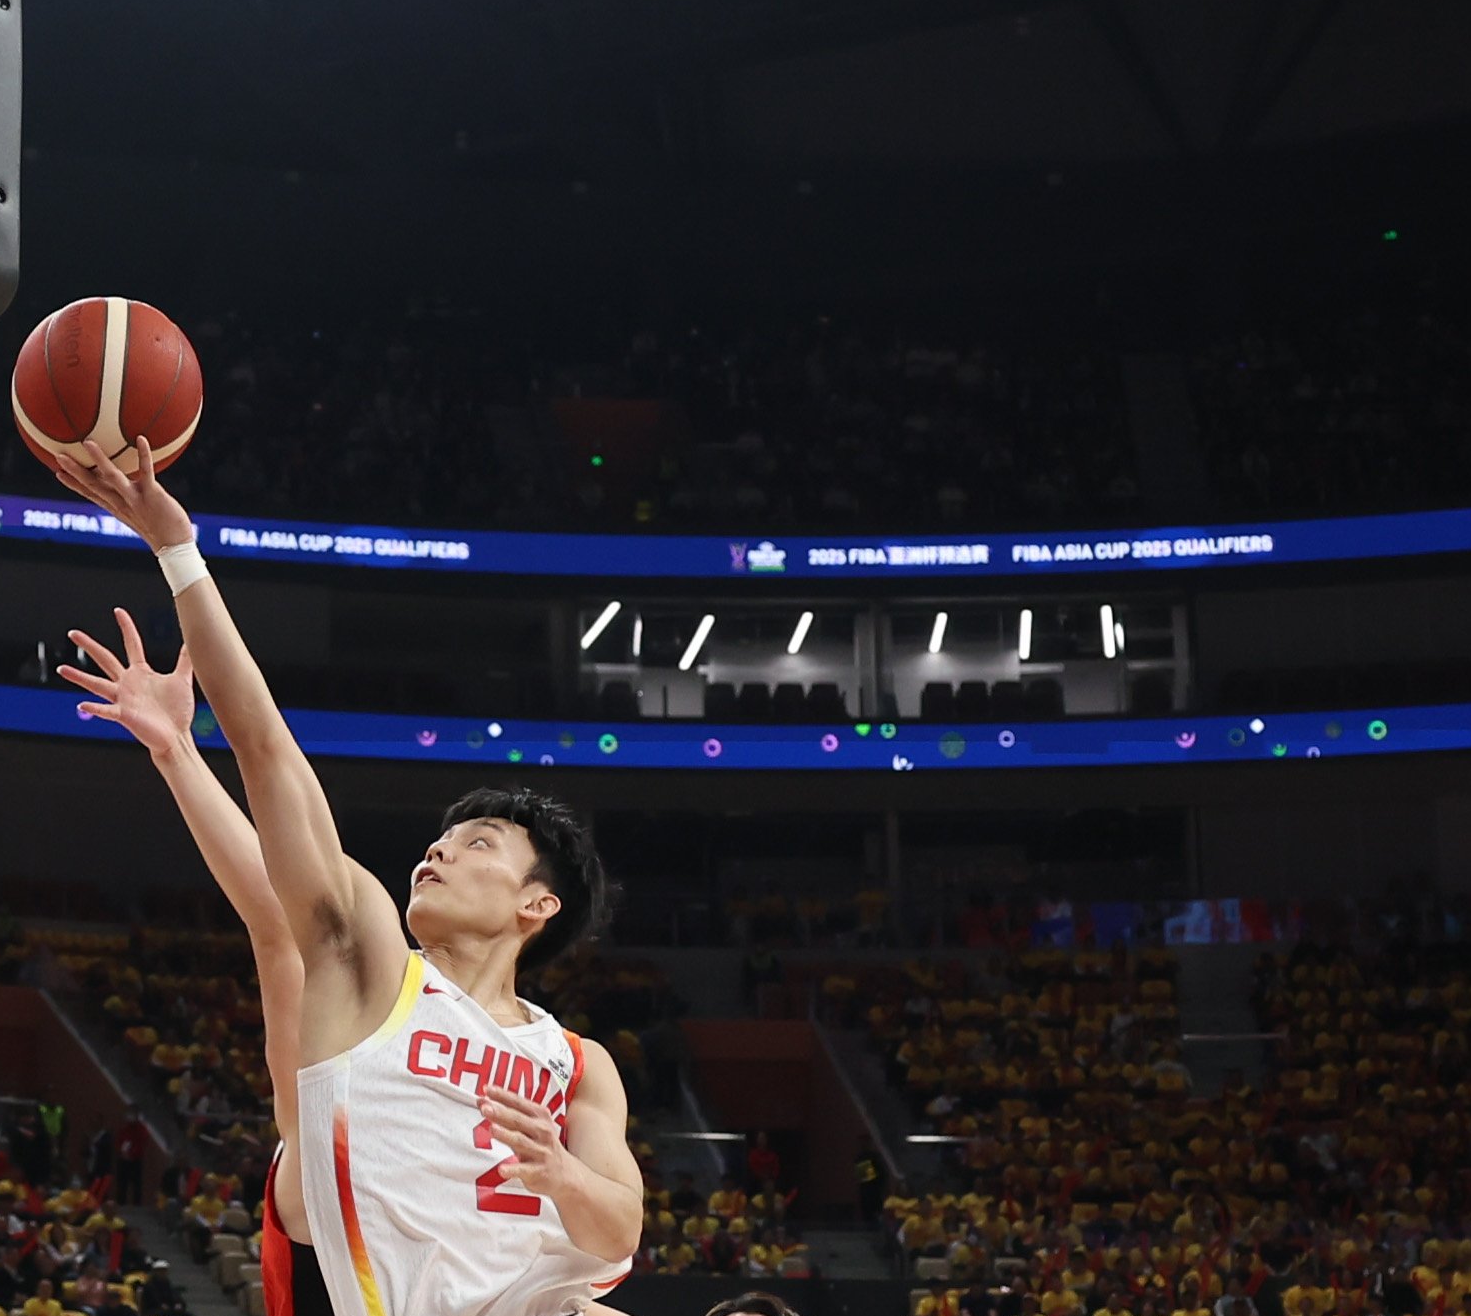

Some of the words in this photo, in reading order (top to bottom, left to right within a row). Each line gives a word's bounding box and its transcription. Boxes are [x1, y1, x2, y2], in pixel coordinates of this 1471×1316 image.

[22, 509, 60, 530] 2025
[62, 512, 100, 534] FIBA
[220, 526, 258, 547] FIBA
[259, 530, 298, 551] ASIA
[299, 532, 333, 552] CUP
[333, 534, 373, 555] 2025
[374, 536, 471, 561] QUALIFIERS
[808, 546, 847, 567] 2025
[848, 545, 887, 566] FIBA
[1012, 543, 1053, 563] FIBA
[1054, 541, 1094, 562] ASIA
[1095, 540, 1130, 561] CUP
[1131, 538, 1171, 559] 2025
[1173, 534, 1274, 559] QUALIFIERS
